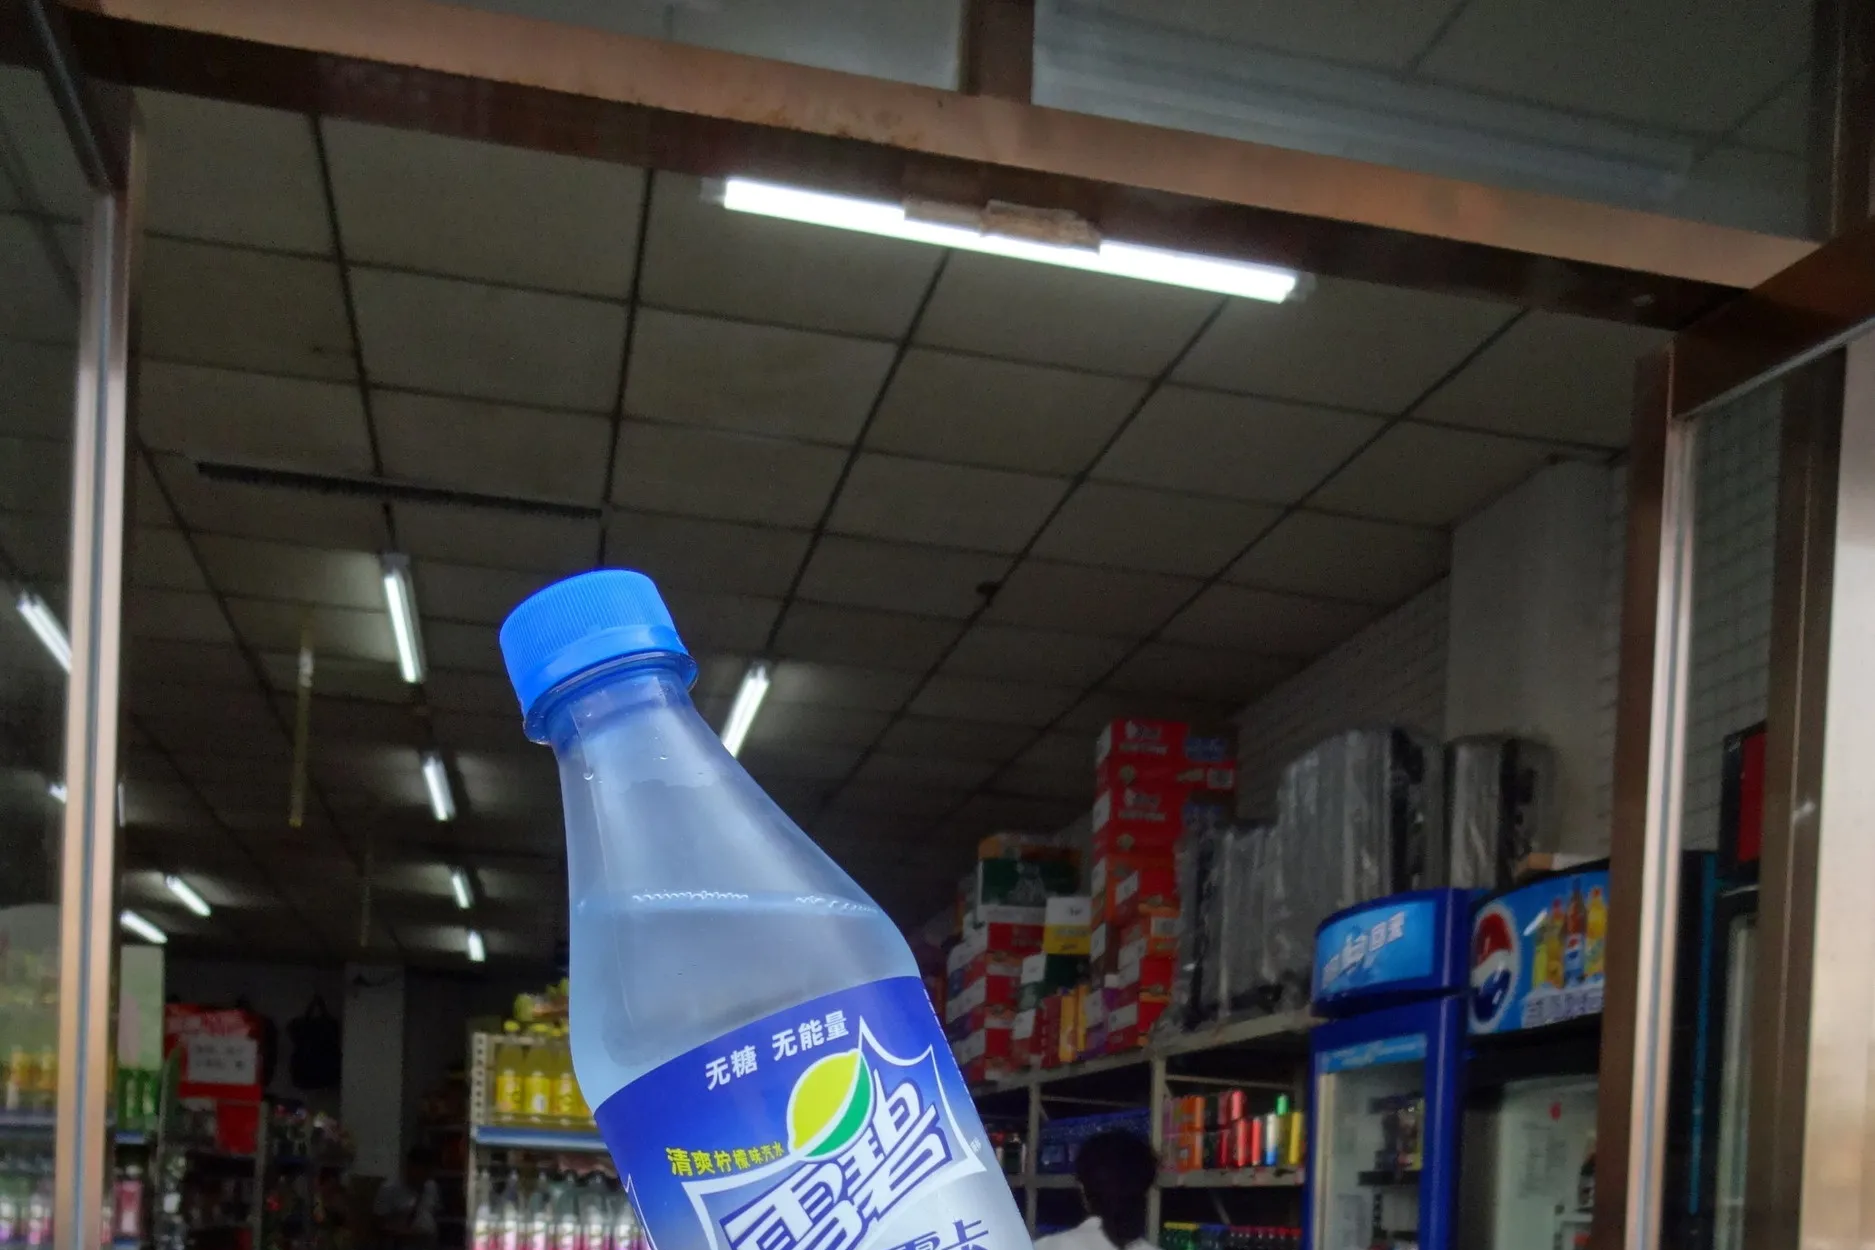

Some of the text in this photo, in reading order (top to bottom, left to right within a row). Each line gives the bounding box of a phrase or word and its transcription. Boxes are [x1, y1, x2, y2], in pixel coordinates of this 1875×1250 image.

[704, 1009, 850, 1092] 无糖 无能量
[665, 1140, 785, 1177] 清爽柠檬味汽水
